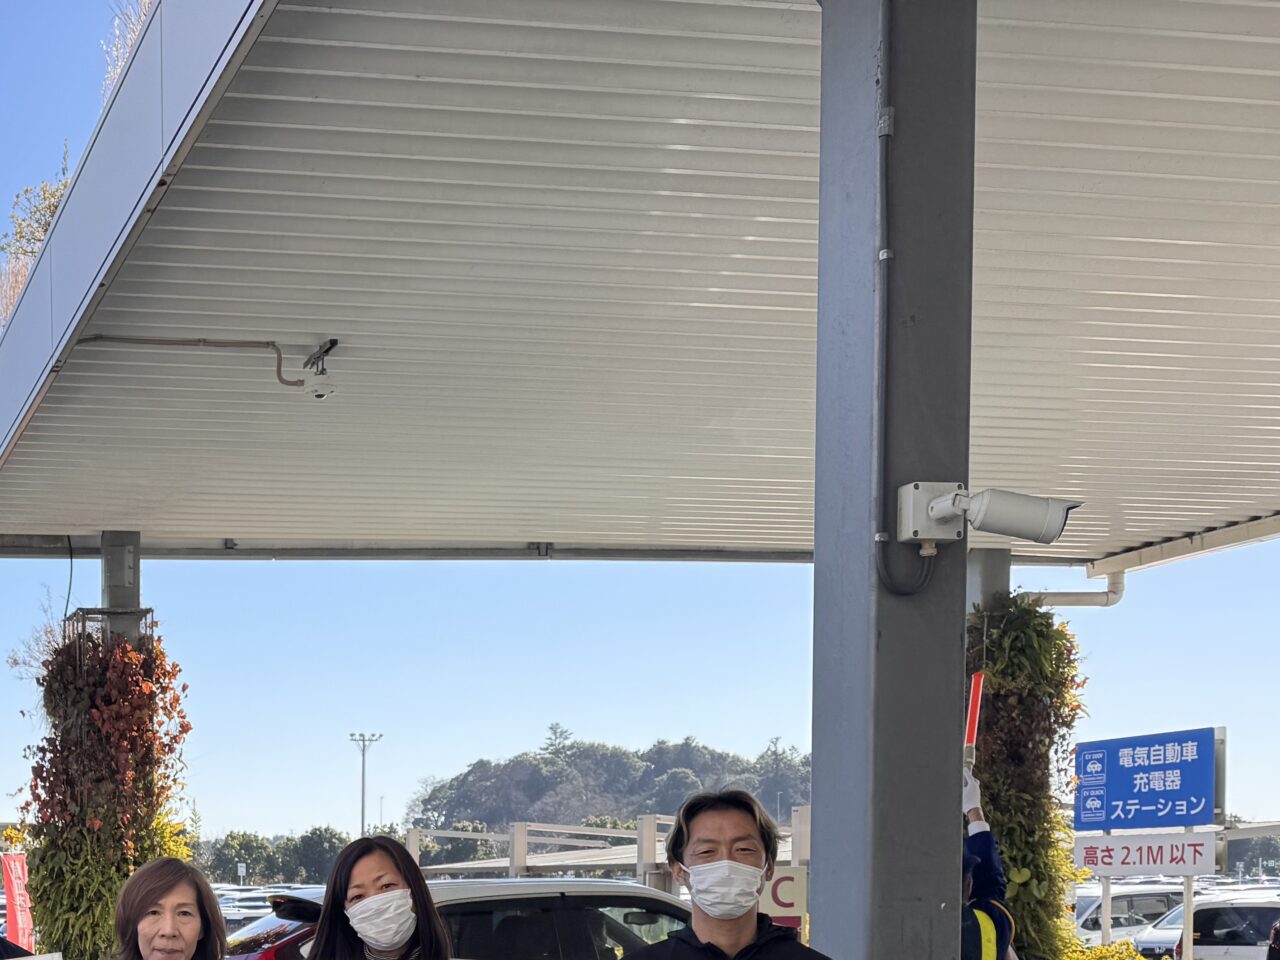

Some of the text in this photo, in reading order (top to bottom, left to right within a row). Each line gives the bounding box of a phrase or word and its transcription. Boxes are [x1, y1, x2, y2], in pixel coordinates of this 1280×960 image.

[1118, 741, 1199, 768] 電気自動車
[1133, 770, 1181, 793] 充電器
[1110, 797, 1206, 820] ステーション
